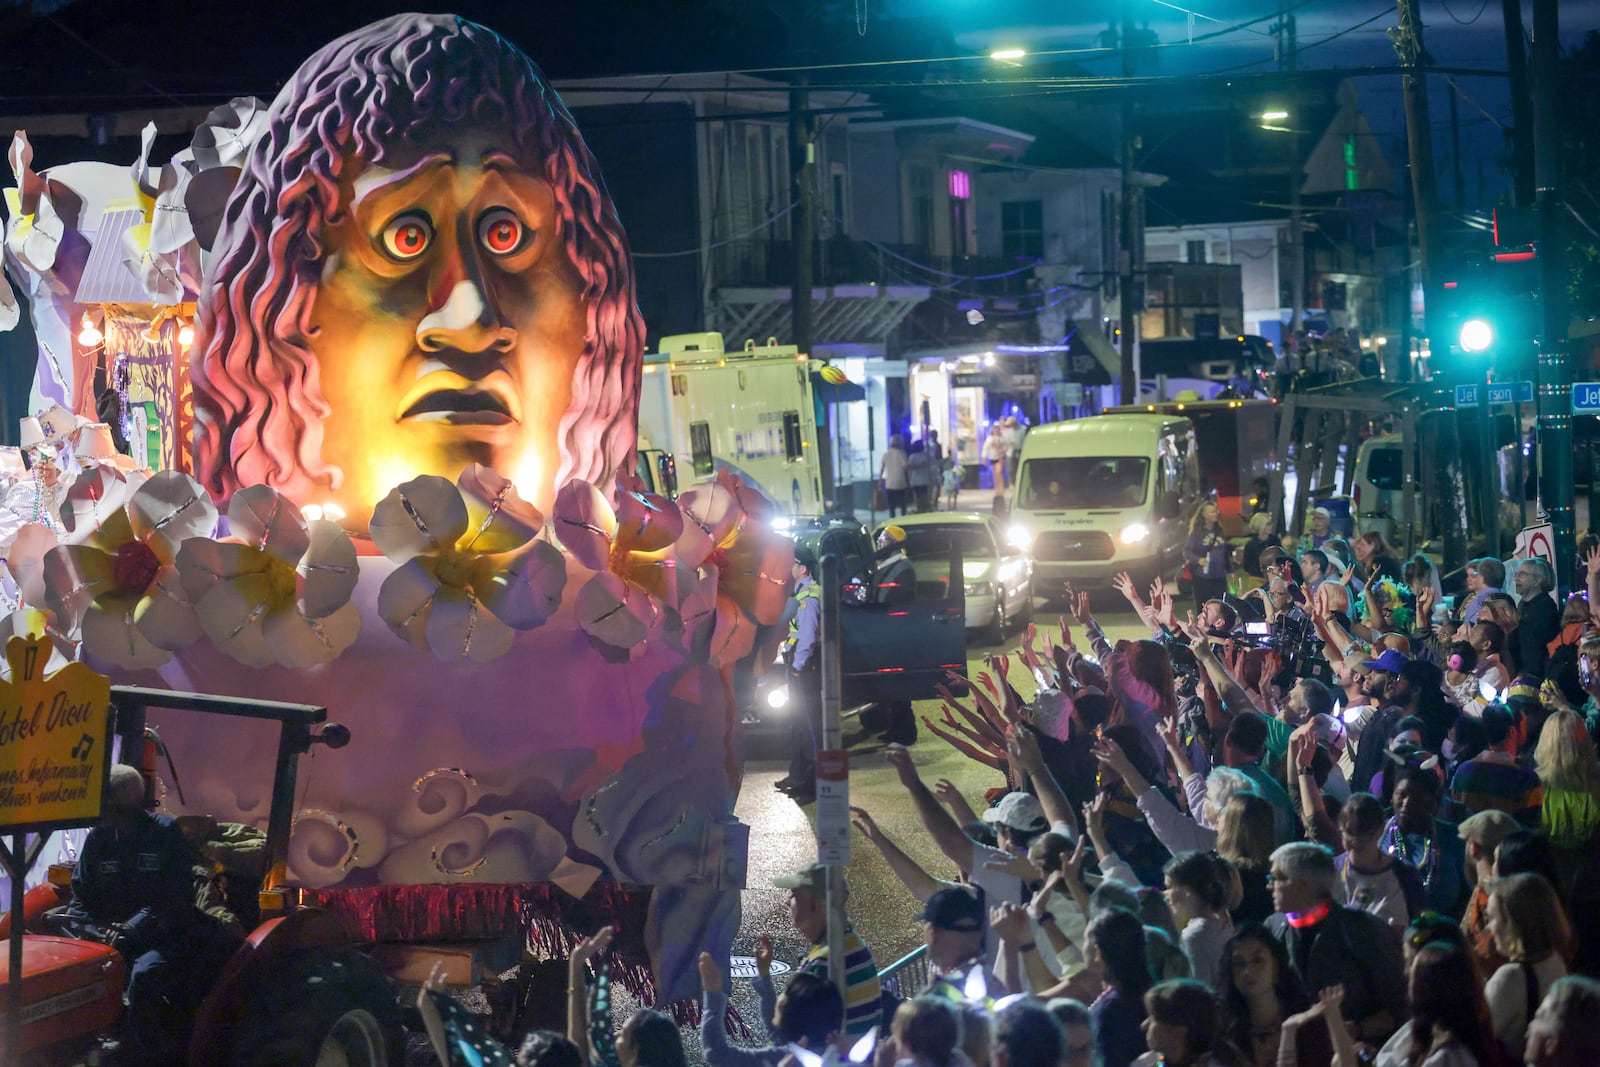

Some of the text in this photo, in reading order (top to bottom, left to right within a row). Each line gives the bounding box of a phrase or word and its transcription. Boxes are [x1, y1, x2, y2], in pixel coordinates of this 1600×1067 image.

[1460, 387, 1513, 402] Jefrson
[24, 646, 38, 681] 17
[46, 690, 92, 733] Dieu
